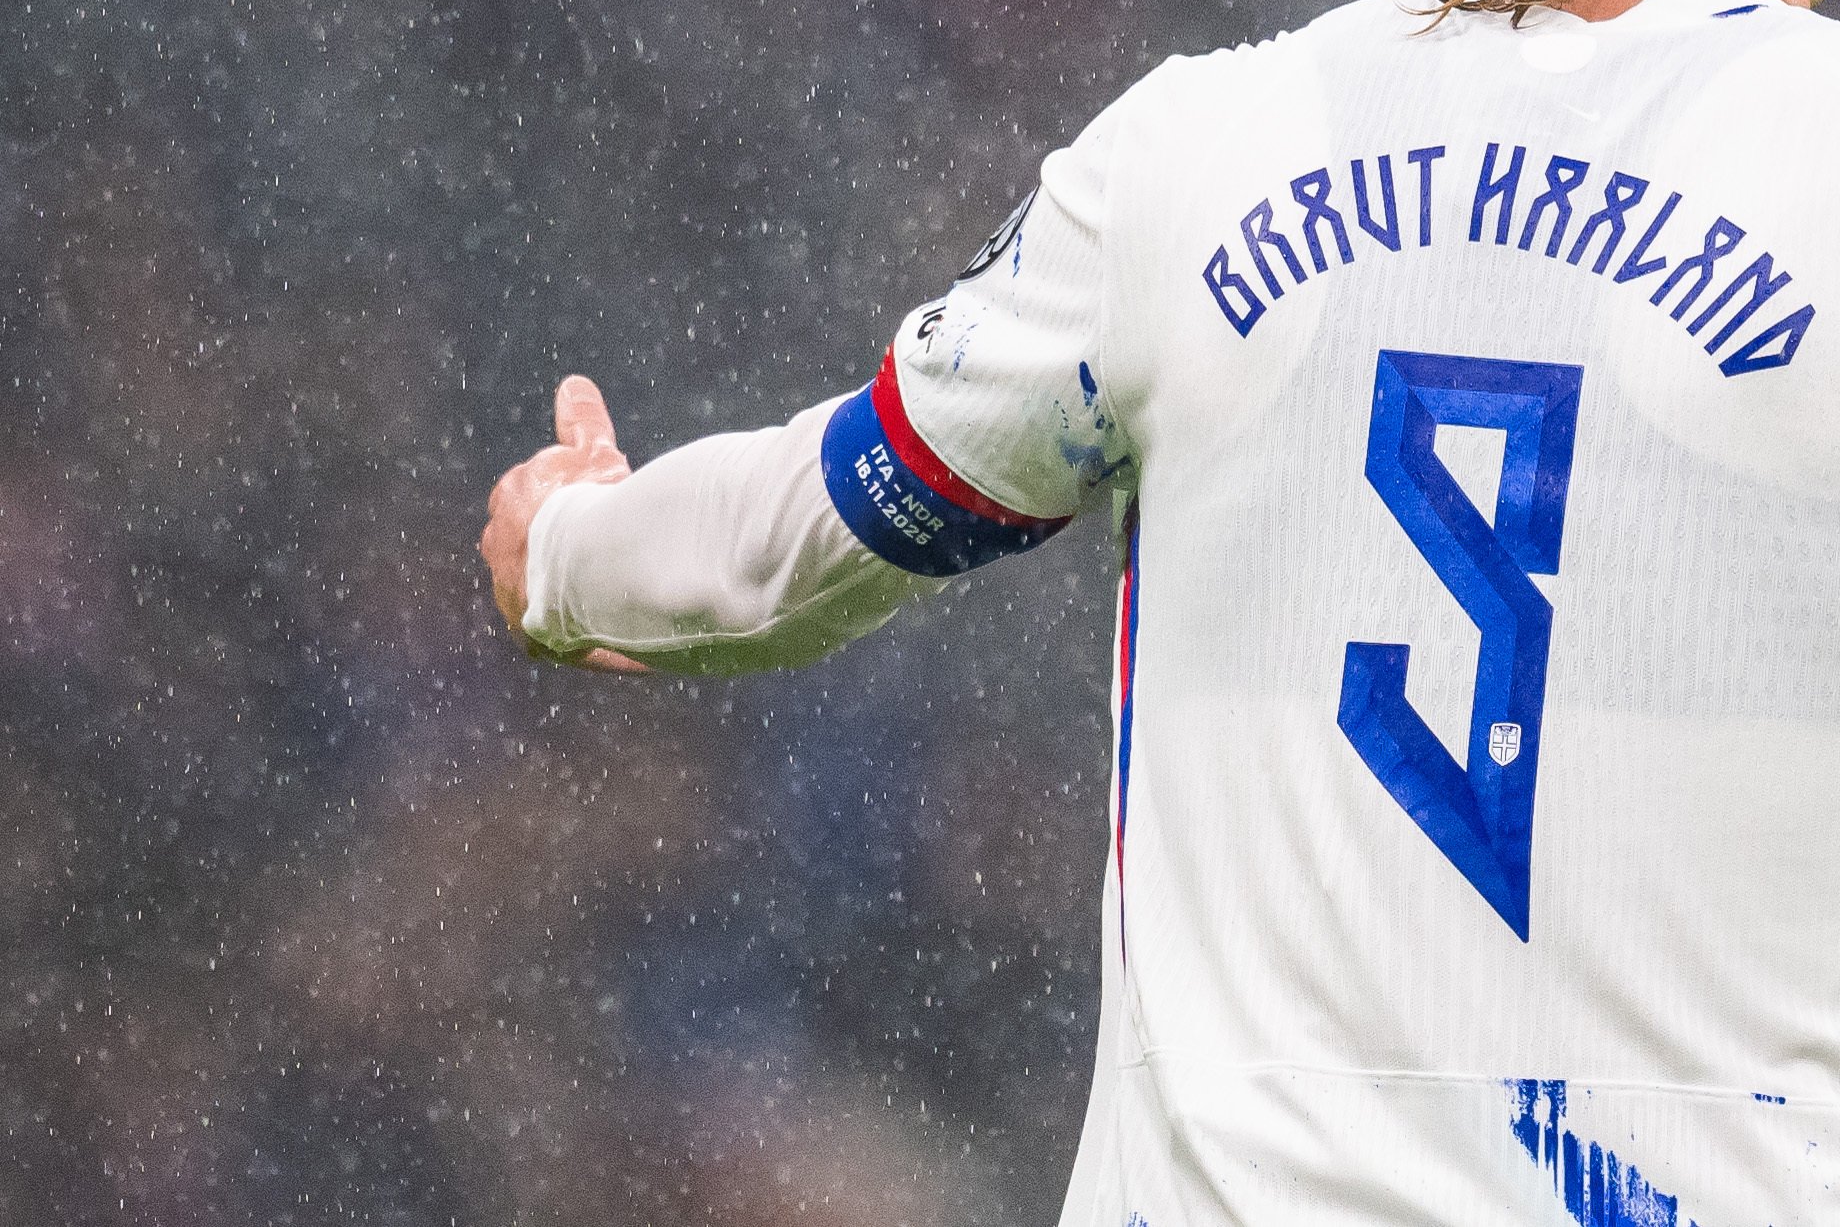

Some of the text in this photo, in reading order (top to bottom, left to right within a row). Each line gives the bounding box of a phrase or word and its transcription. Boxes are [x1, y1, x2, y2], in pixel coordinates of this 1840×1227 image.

[1202, 142, 1817, 378] BRAUT HAALAND
[870, 442, 895, 483] ITA
[901, 493, 944, 532] NOR
[1336, 348, 1585, 944] 9
